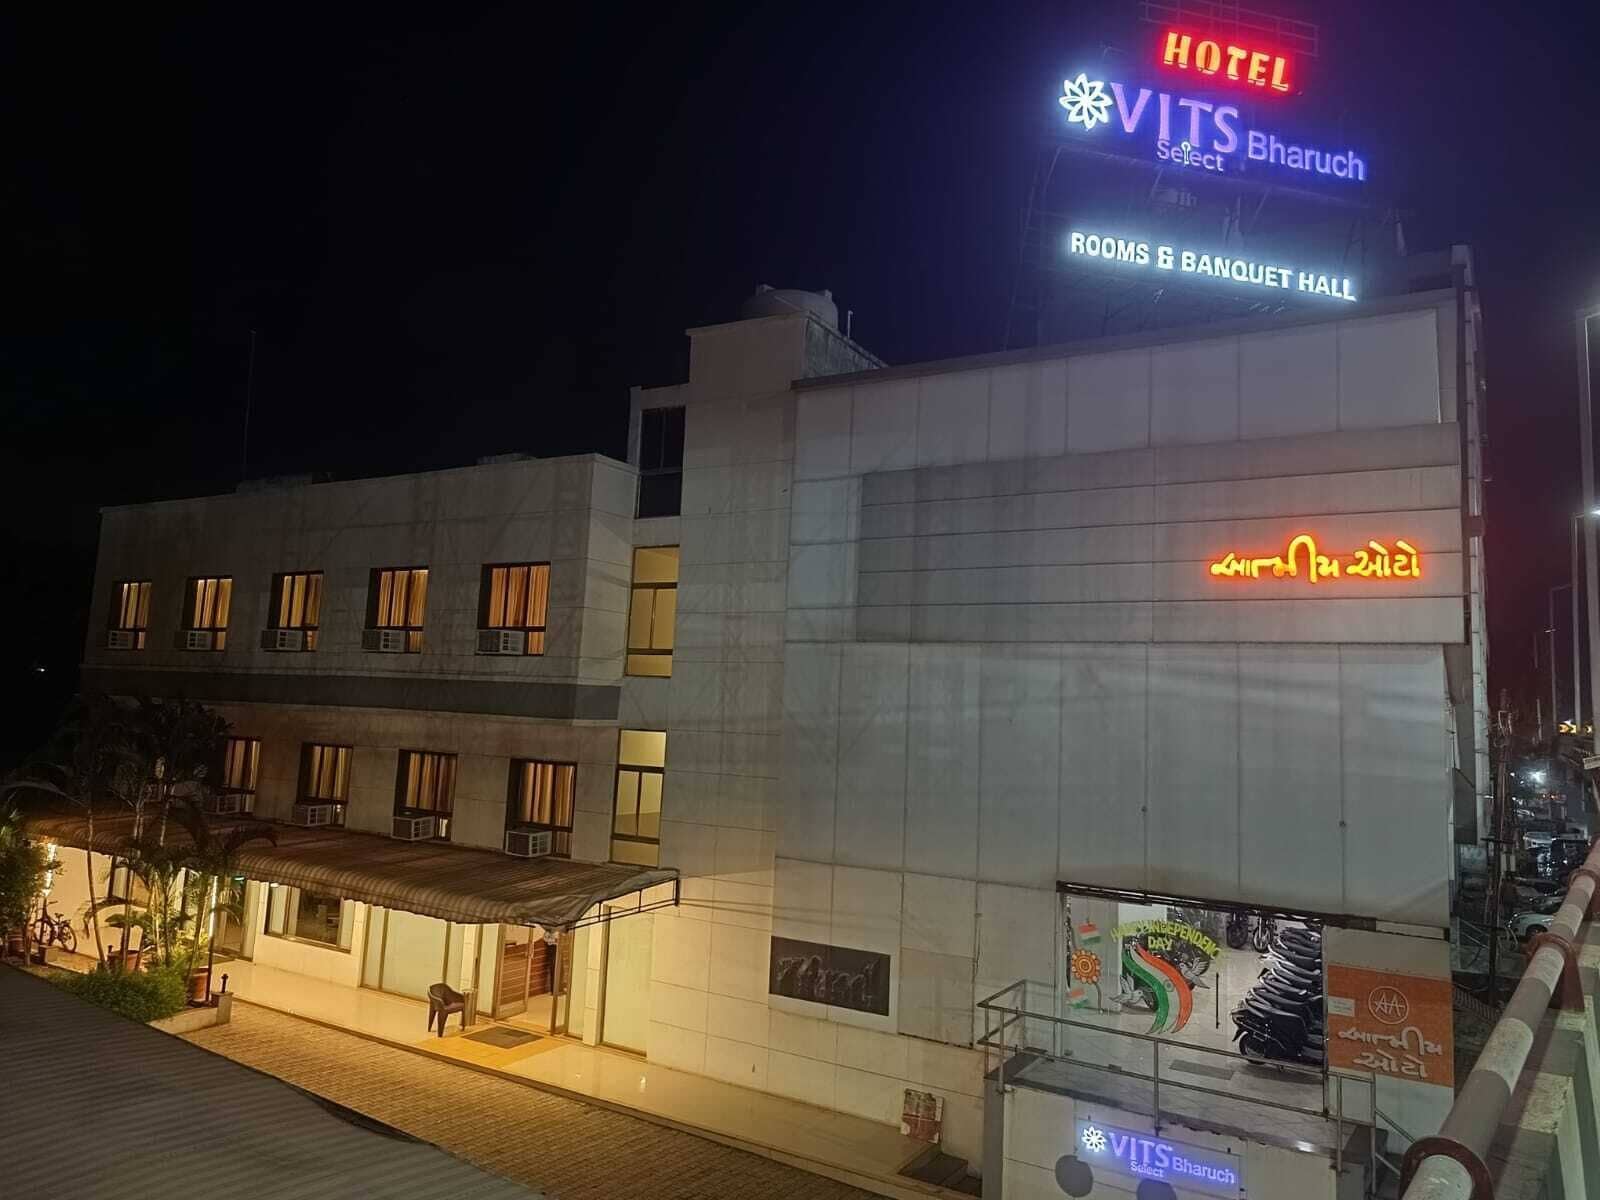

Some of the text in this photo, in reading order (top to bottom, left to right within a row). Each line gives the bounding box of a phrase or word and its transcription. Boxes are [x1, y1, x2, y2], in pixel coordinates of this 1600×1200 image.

[1163, 31, 1290, 92] HOTEL
[1110, 82, 1367, 182] VITS Bharuch
[1157, 139, 1225, 172] Select
[1071, 232, 1357, 301] ROOMS & BANQUET HALL
[1346, 540, 1420, 577] ઓટો
[1147, 919, 1227, 965] INDEPENDENC
[1148, 936, 1173, 951] DAY
[1108, 1133, 1235, 1184] VITS Bharuch
